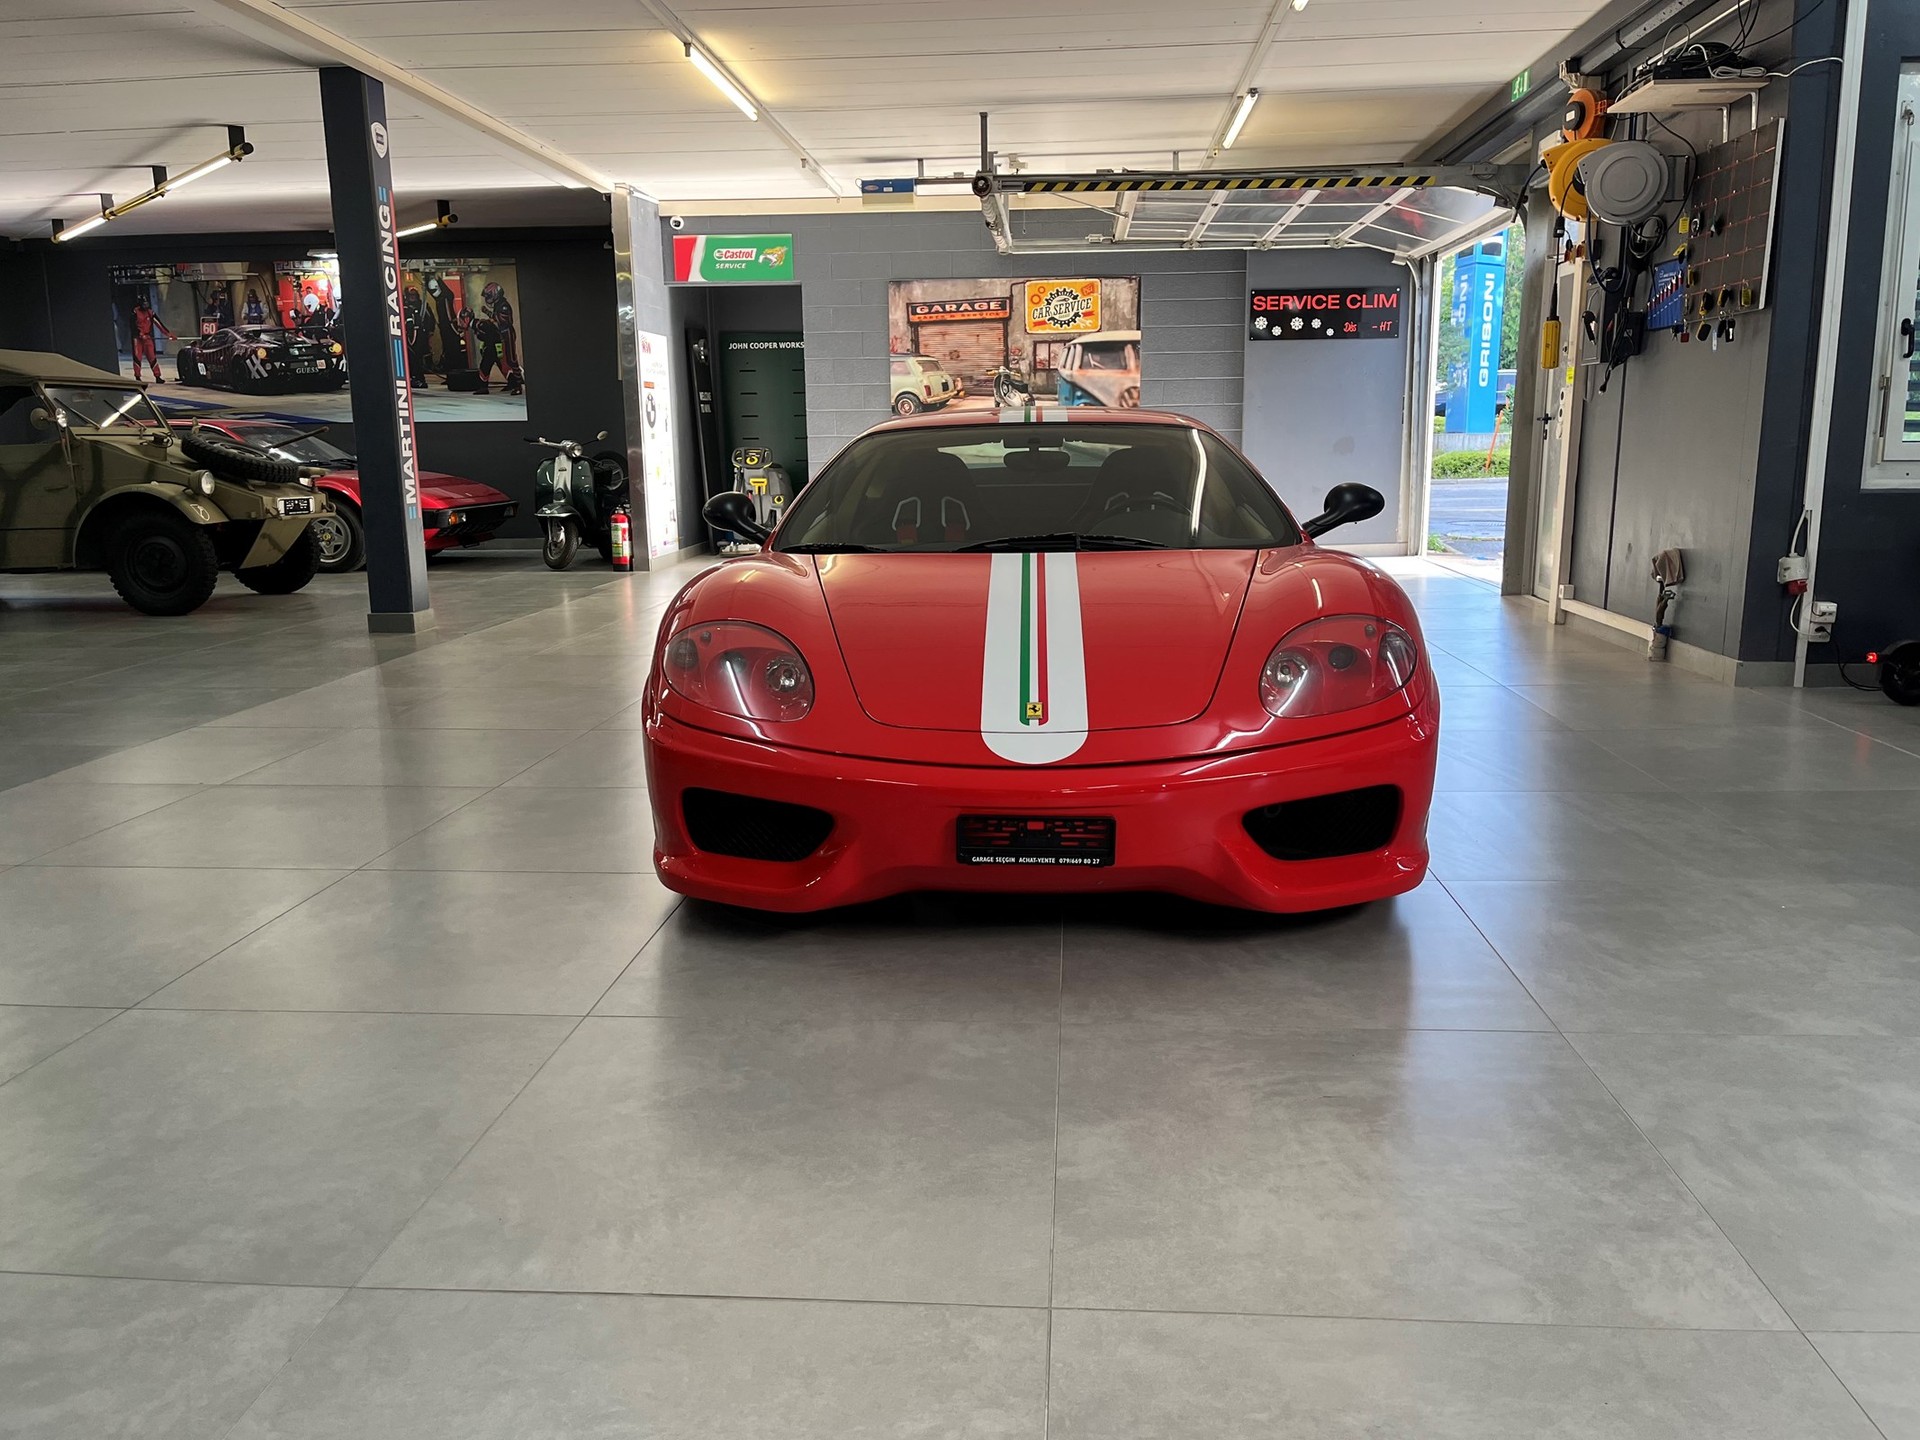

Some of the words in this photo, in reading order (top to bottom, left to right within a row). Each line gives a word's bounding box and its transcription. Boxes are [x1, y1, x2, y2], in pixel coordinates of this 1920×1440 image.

[723, 249, 754, 259] Castrol
[378, 204, 402, 337] RACING
[916, 301, 1002, 314] GARAGE
[1252, 294, 1341, 311] SERVICE
[1346, 293, 1398, 309] CLIM
[1032, 305, 1052, 320] CAR
[1053, 298, 1092, 316] SERVICE
[202, 323, 216, 335] 60
[1379, 321, 1393, 332] HT
[1478, 272, 1496, 388] GRIBONI
[728, 342, 748, 350] JOHN
[779, 341, 805, 349] WORKS
[295, 367, 319, 375] GUESS
[395, 379, 417, 505] MARTINI
